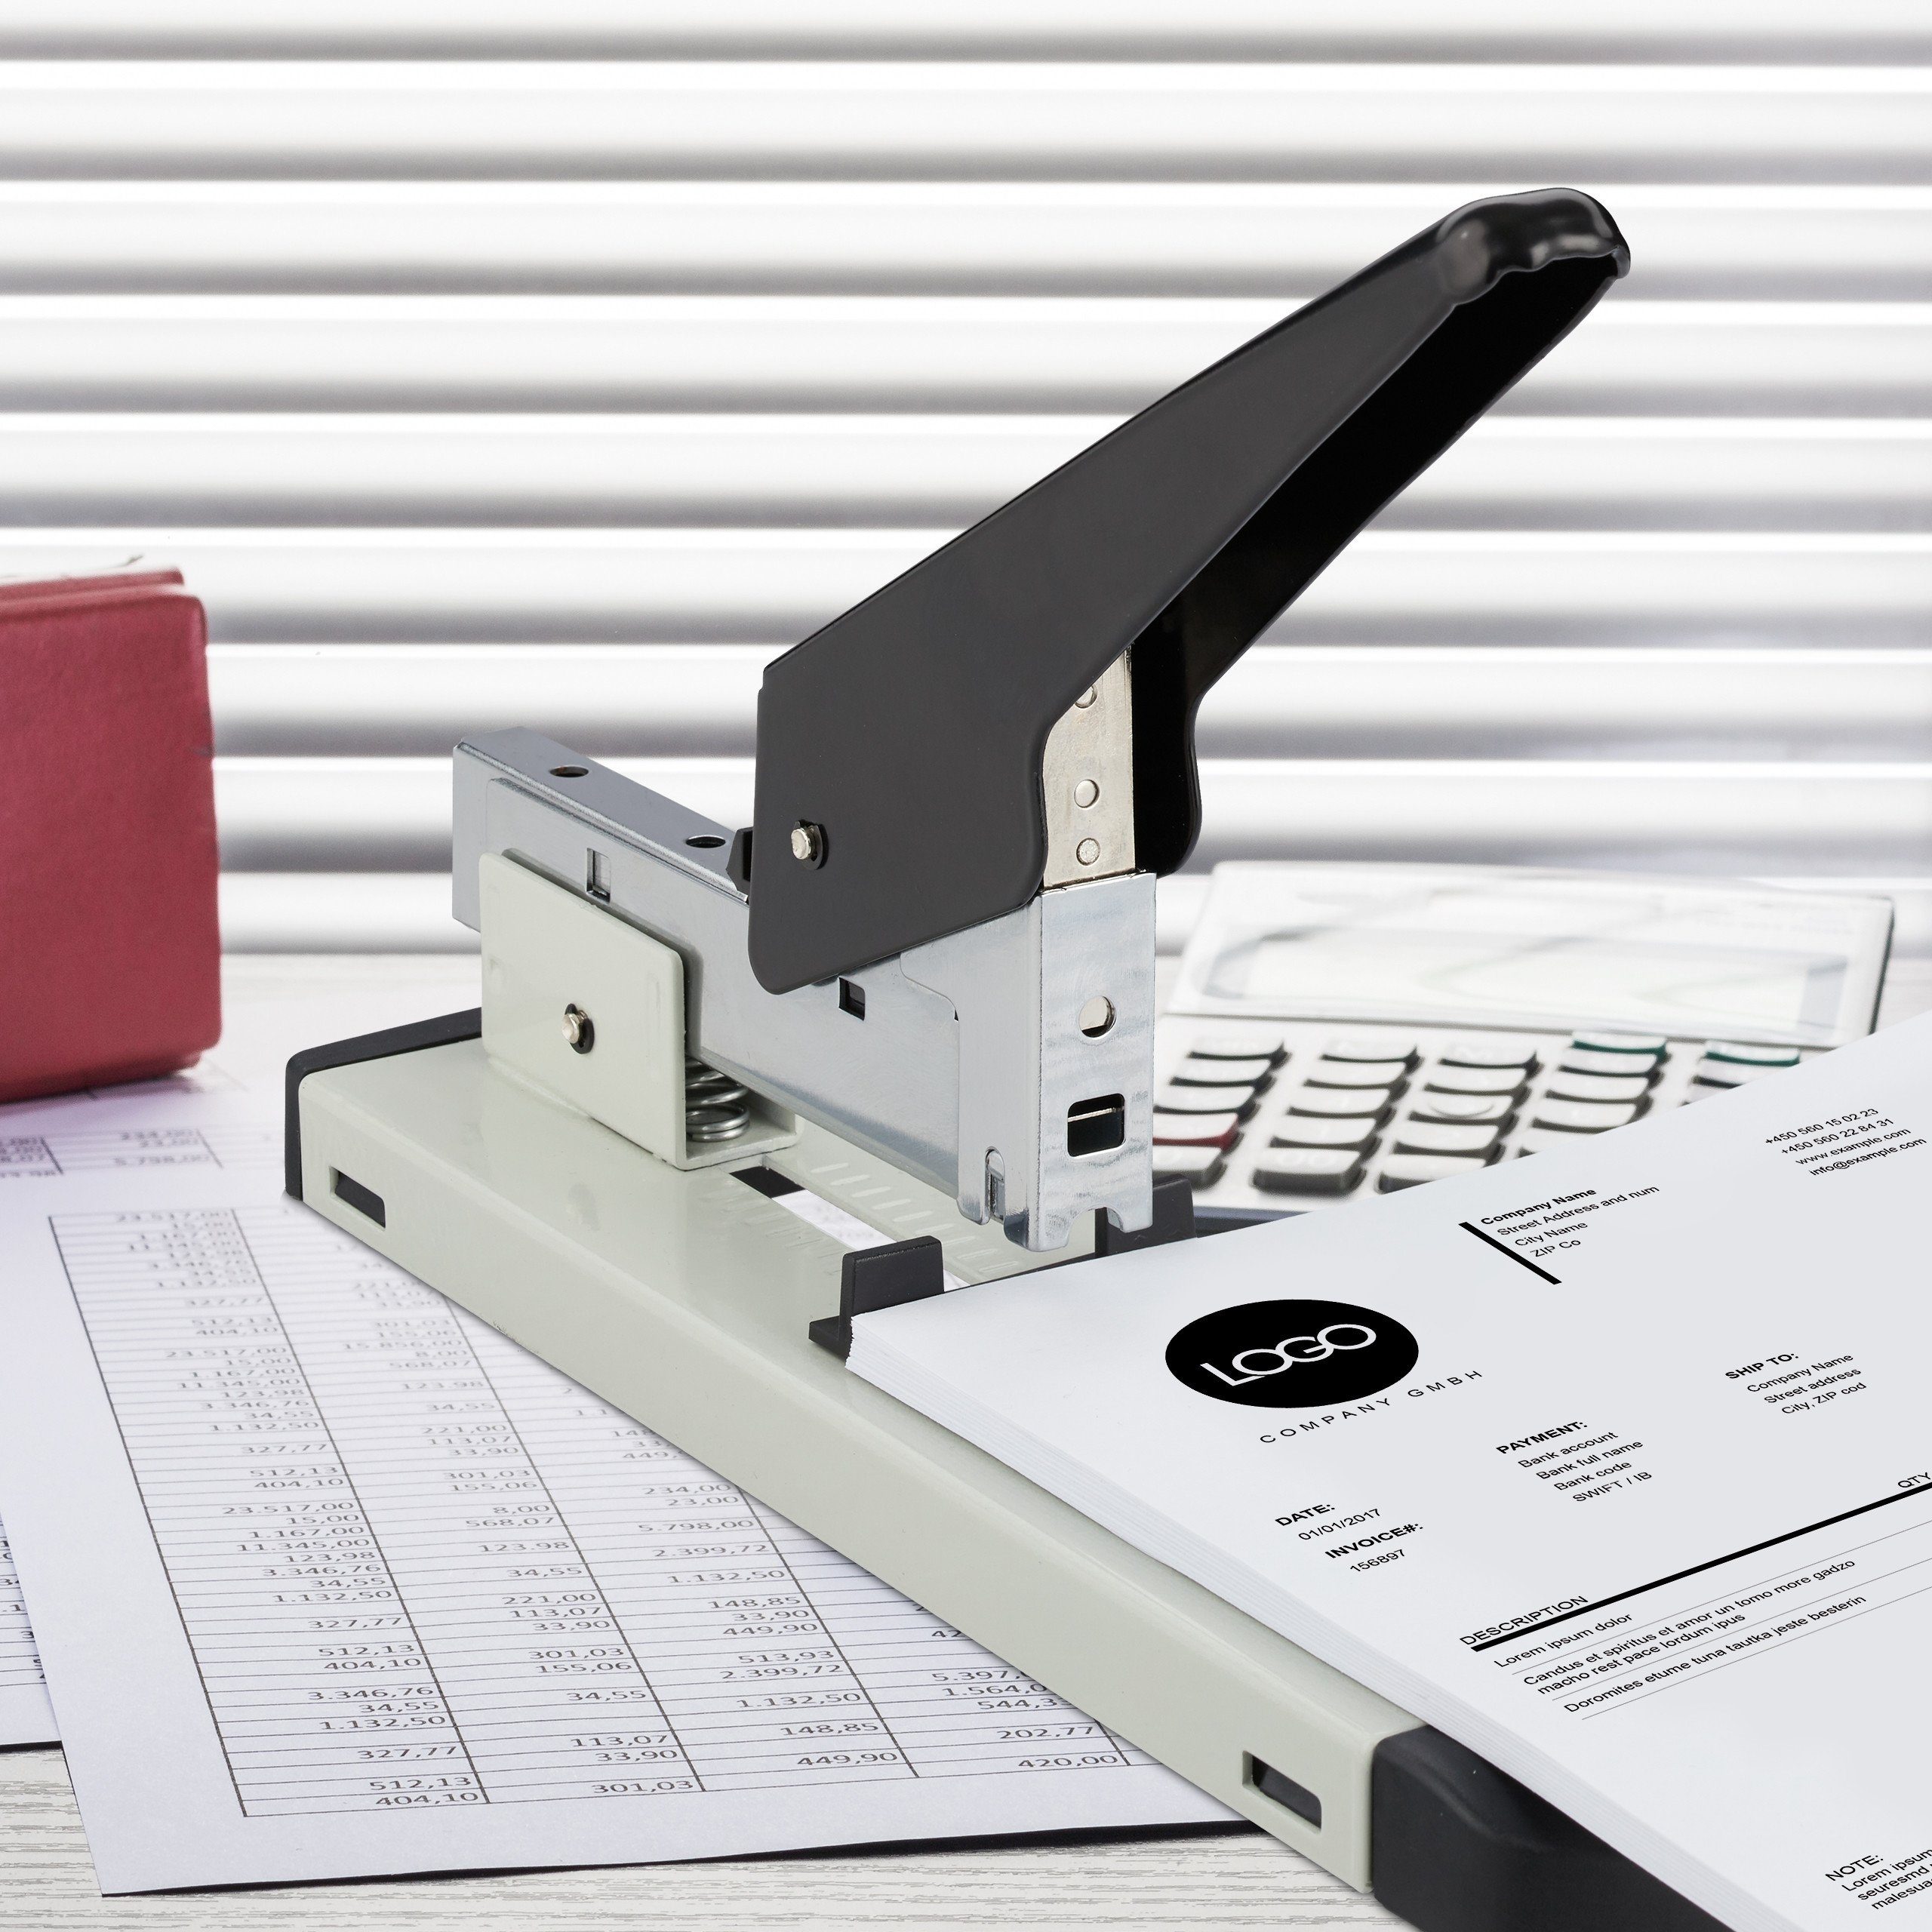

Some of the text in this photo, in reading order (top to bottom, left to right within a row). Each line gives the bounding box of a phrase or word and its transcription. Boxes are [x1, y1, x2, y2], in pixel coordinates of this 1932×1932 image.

[1765, 1108, 1878, 1145] +450 560 15 02 23
[1781, 1118, 1894, 1155] +450 560 22 84 31
[1795, 1128, 1911, 1164] www.example.com
[1810, 1138, 1927, 1176] info@example.com
[1481, 1189, 1596, 1225] Company Name
[1497, 1185, 1660, 1235] Street Address and num
[1515, 1222, 1588, 1247] City Name
[1530, 1238, 1581, 1257] ZIP Co
[1200, 1324, 1377, 1386] LOGO
[1725, 1353, 1799, 1379] SHIP TO:
[1747, 1355, 1854, 1392] Company Name
[1764, 1368, 1861, 1404] Street address
[1781, 1382, 1867, 1414] City, ZIP cod
[1260, 1370, 1483, 1444] COMPANY GMBH
[1496, 1421, 1588, 1454] PAYMENT:
[242, 1444, 327, 1454] 327,77
[448, 1447, 518, 1457] 33,90
[1518, 1432, 1619, 1468] Bank account
[1536, 1441, 1644, 1479] Bank full name
[250, 1466, 339, 1477] 512,13
[443, 1470, 531, 1480] 301,03
[1553, 1461, 1632, 1491] Bank code
[254, 1478, 344, 1489] 404,10
[449, 1481, 537, 1492] 155,06
[1572, 1480, 1623, 1502] SWIFT
[1633, 1471, 1653, 1481] IB
[1898, 1472, 1931, 1487] QTY
[644, 1484, 732, 1496] 234,00
[668, 1495, 740, 1507] 23,00
[223, 1502, 355, 1515] 23.517,00
[493, 1504, 550, 1515] 8,00
[1275, 1504, 1336, 1526] DATE:
[286, 1514, 359, 1524] 15,00
[466, 1517, 555, 1528] 568,07
[1298, 1509, 1381, 1540] 01/01/2017
[249, 1526, 365, 1538] 1.167,00
[638, 1520, 755, 1533] 5.798,00
[237, 1539, 370, 1552] 11.345,00
[1324, 1523, 1423, 1558] INVOICE#:
[284, 1552, 376, 1563] 123,98
[651, 1544, 771, 1558] 2.399,72
[1350, 1549, 1405, 1572] 156897
[262, 1564, 381, 1577] 3.346,76
[507, 1567, 583, 1578] 34,55
[667, 1570, 785, 1584] 1.132,50
[310, 1577, 386, 1588] 34,55
[273, 1590, 392, 1603] 1.132,50
[501, 1593, 596, 1605] 221,00
[708, 1595, 801, 1610] 148,85
[509, 1607, 601, 1619] 113,07
[731, 1610, 809, 1622] 33,90
[1460, 1595, 1589, 1645] DESCRIPTION
[308, 1617, 401, 1629] 327,77
[533, 1620, 611, 1632] 33,90
[722, 1623, 817, 1636] 449,90
[1523, 1560, 1856, 1685] Candus et spiritus et amor un tomo more gadzo
[1494, 1614, 1633, 1668] Lorem ipsum dolor
[319, 1644, 415, 1657] 512,13
[528, 1647, 625, 1660] 301,03
[738, 1650, 835, 1664] 513,93
[1537, 1613, 1746, 1695] macho rest pace lordum ipus
[1564, 1595, 1867, 1712] Doromites etume tuna tautka jeste besterin
[324, 1658, 421, 1671] 404,10
[535, 1662, 632, 1674] 155,06
[719, 1664, 844, 1680] 2.399,72
[308, 1687, 434, 1700] 3.346,76
[567, 1690, 647, 1702] 34,55
[942, 1684, 1048, 1697] 1.564,0
[358, 1701, 439, 1713] 34,55
[737, 1693, 861, 1708] 1.132,50
[319, 1715, 445, 1730] 1.132,50
[780, 1722, 879, 1737] 148,85
[997, 1726, 1094, 1740] 202,77
[571, 1735, 668, 1748] 113,07
[358, 1746, 457, 1759] 327,77
[595, 1749, 678, 1762] 33,90
[797, 1752, 897, 1767] 449,90
[1018, 1755, 1118, 1768] 420,00
[369, 1777, 472, 1792] 512,13
[591, 1780, 694, 1795] 301,03
[375, 1792, 478, 1806] 404,10
[1825, 1855, 1884, 1881] NOTE:
[1841, 1869, 1892, 1891] Lorem
[1857, 1866, 1930, 1900] seuresmd
[1871, 1878, 1932, 1910] malesua
